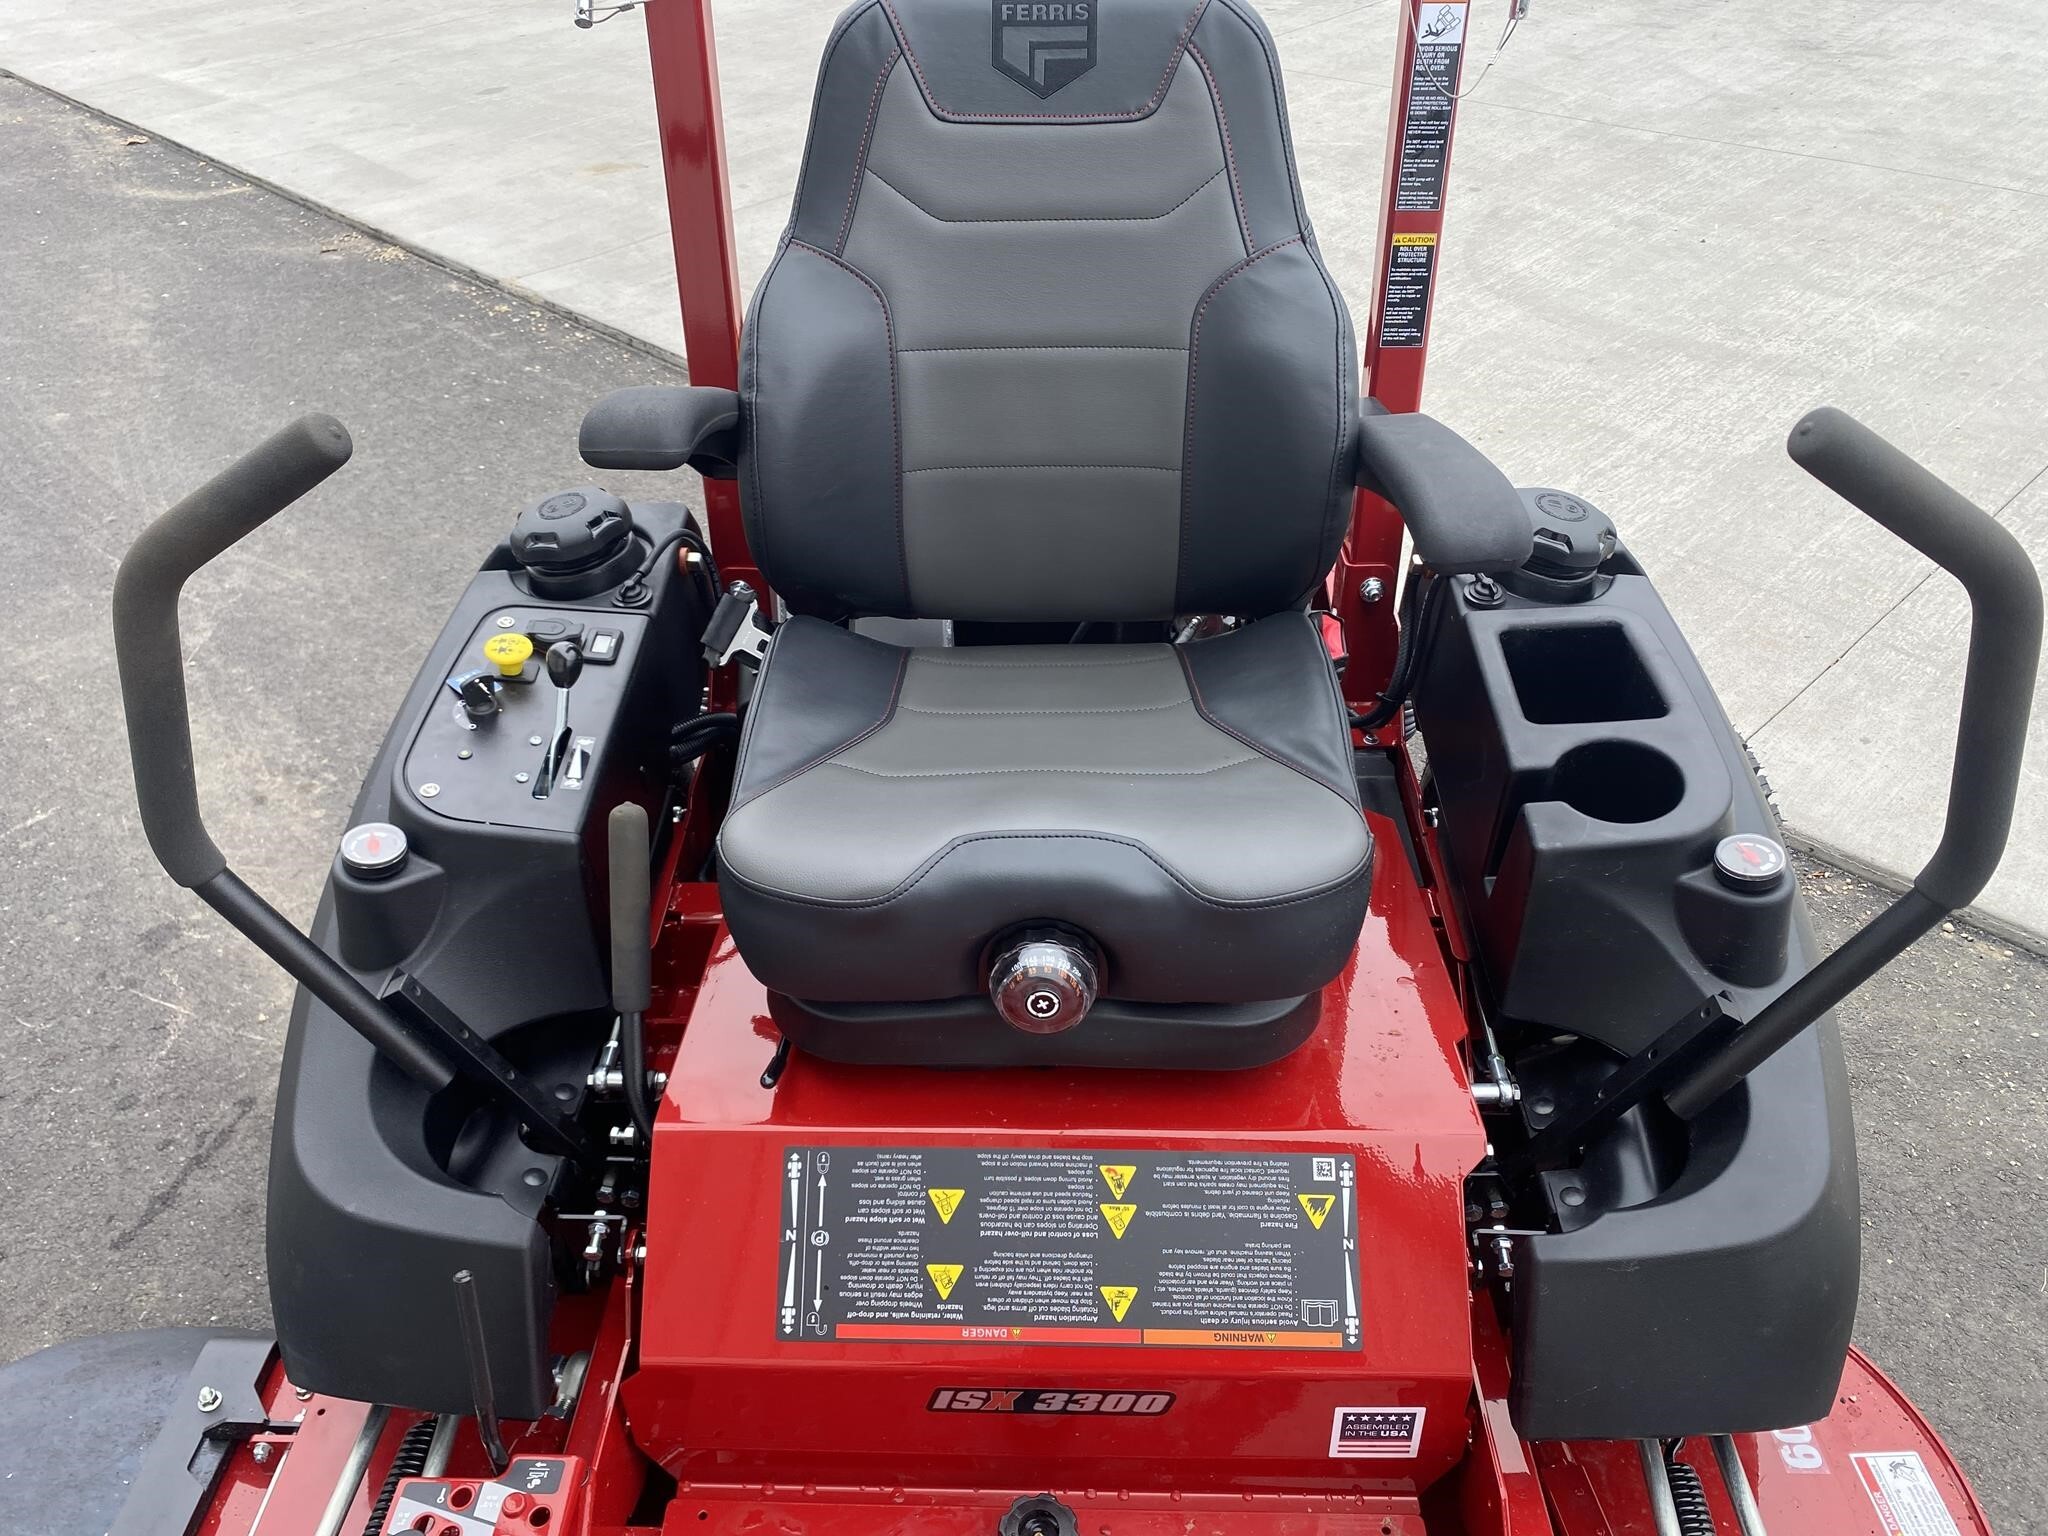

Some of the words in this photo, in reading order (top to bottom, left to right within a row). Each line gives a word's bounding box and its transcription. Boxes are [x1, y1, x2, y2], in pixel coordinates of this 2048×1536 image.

[1001, 4, 1088, 20] FERRIS
[869, 1215, 888, 1223] slope
[786, 1230, 796, 1241] N
[1343, 1238, 1354, 1250] N
[847, 1310, 875, 1319] drop-off
[910, 1311, 941, 1320] retaining
[1058, 1314, 1098, 1322] Amputation
[1230, 1317, 1250, 1325] injury
[962, 1328, 1008, 1338] DANGER
[1214, 1332, 1264, 1342] WARNING
[932, 1390, 1024, 1410] ISX
[1033, 1392, 1170, 1413] 3300
[1873, 1492, 1899, 1531] DANGER
